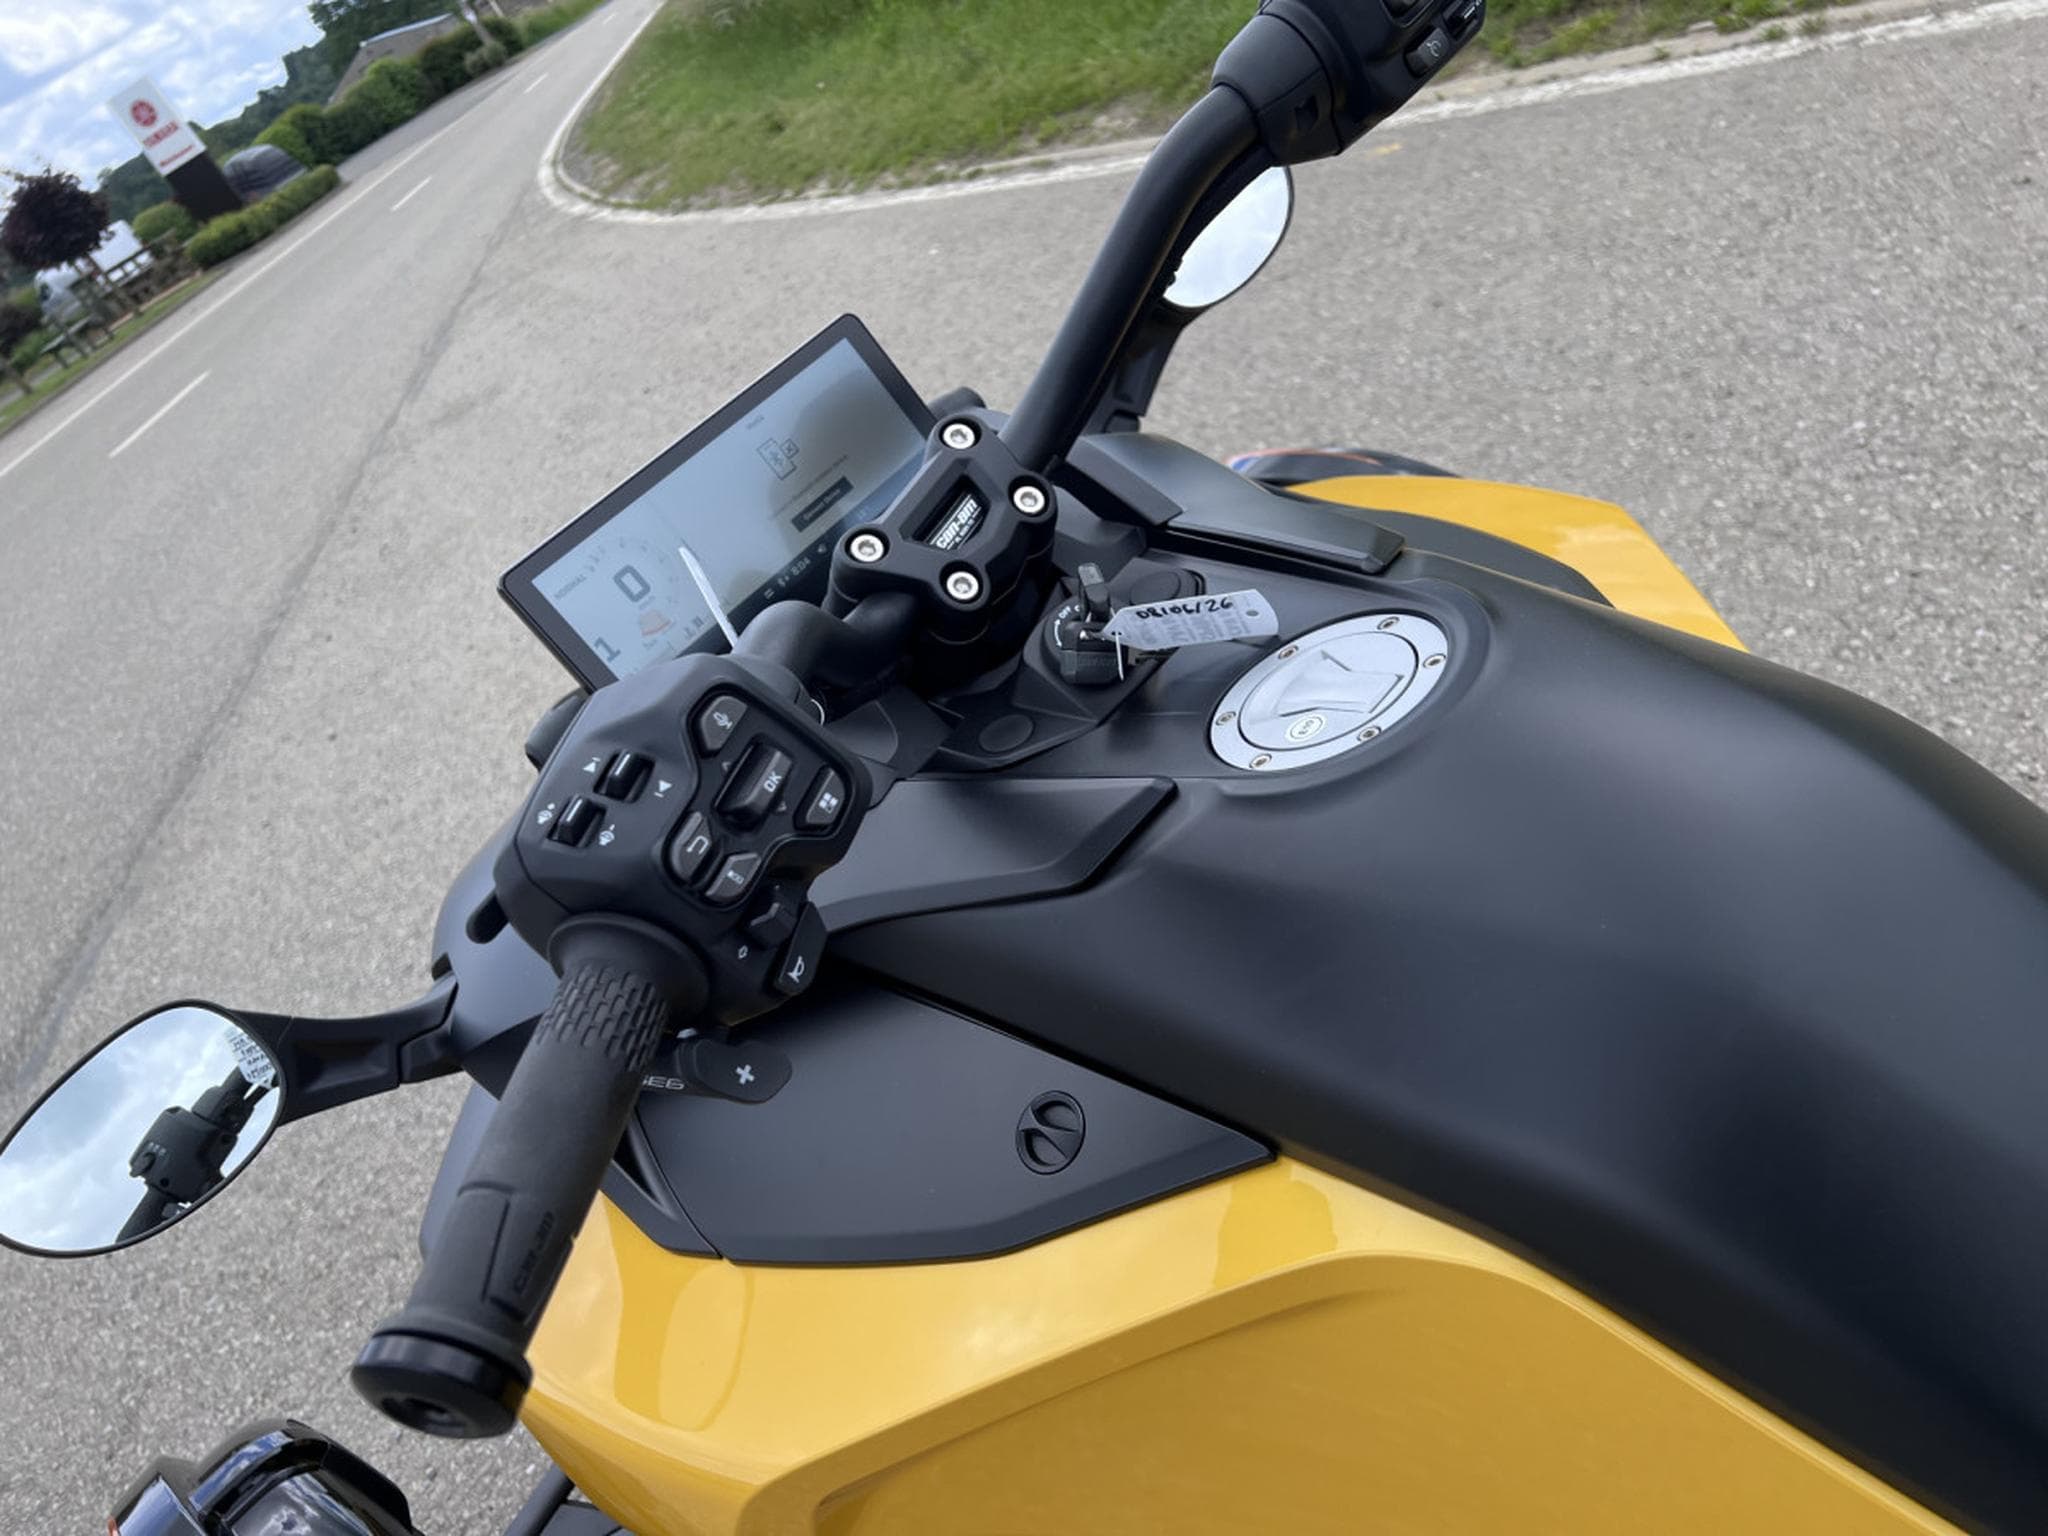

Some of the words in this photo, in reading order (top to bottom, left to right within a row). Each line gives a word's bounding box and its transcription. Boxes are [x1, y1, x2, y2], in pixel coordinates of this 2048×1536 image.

[613, 564, 651, 602] 0
[594, 637, 621, 662] 1
[764, 771, 782, 792] OK
